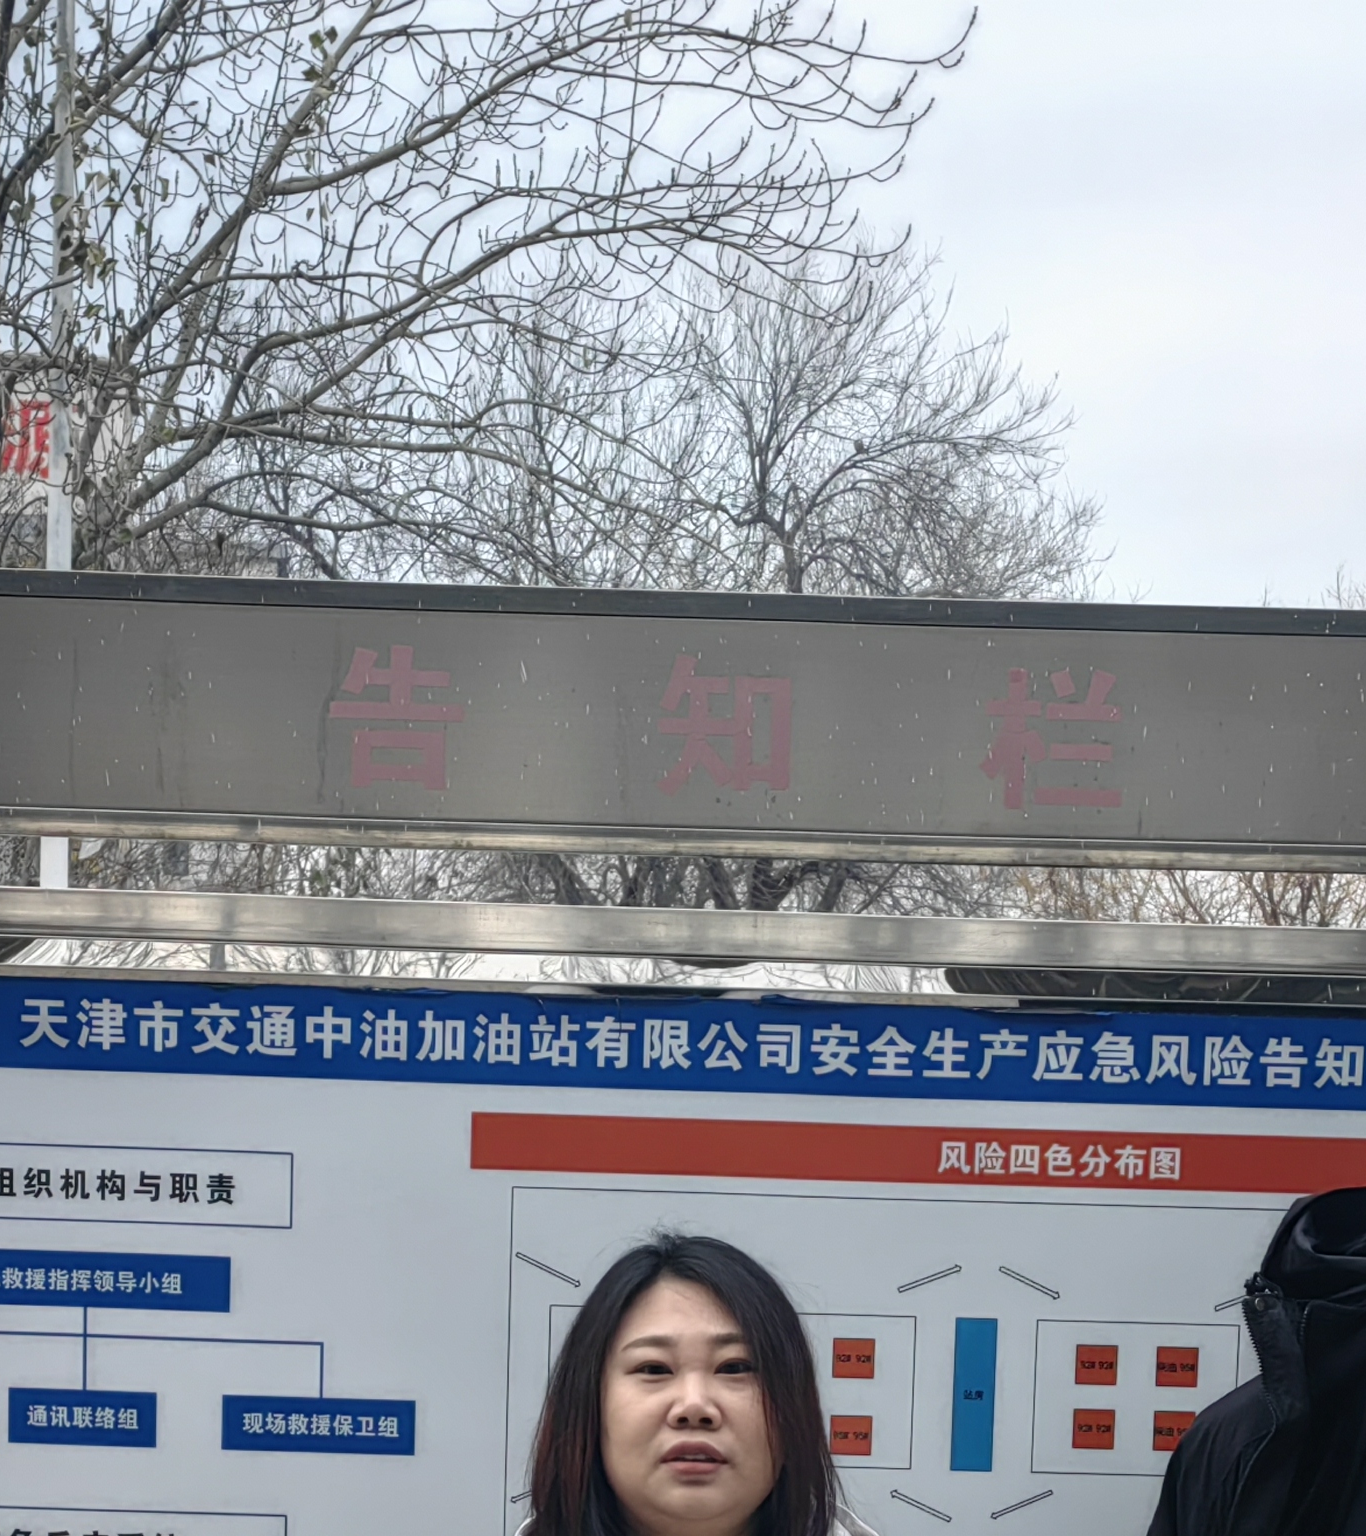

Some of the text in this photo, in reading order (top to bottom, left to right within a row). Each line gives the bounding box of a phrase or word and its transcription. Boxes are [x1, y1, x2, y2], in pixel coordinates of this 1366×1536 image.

[329, 645, 1123, 811] 告知栏
[937, 1140, 1183, 1182] 风险四色分布图
[26, 1405, 140, 1432] 通讯联络组
